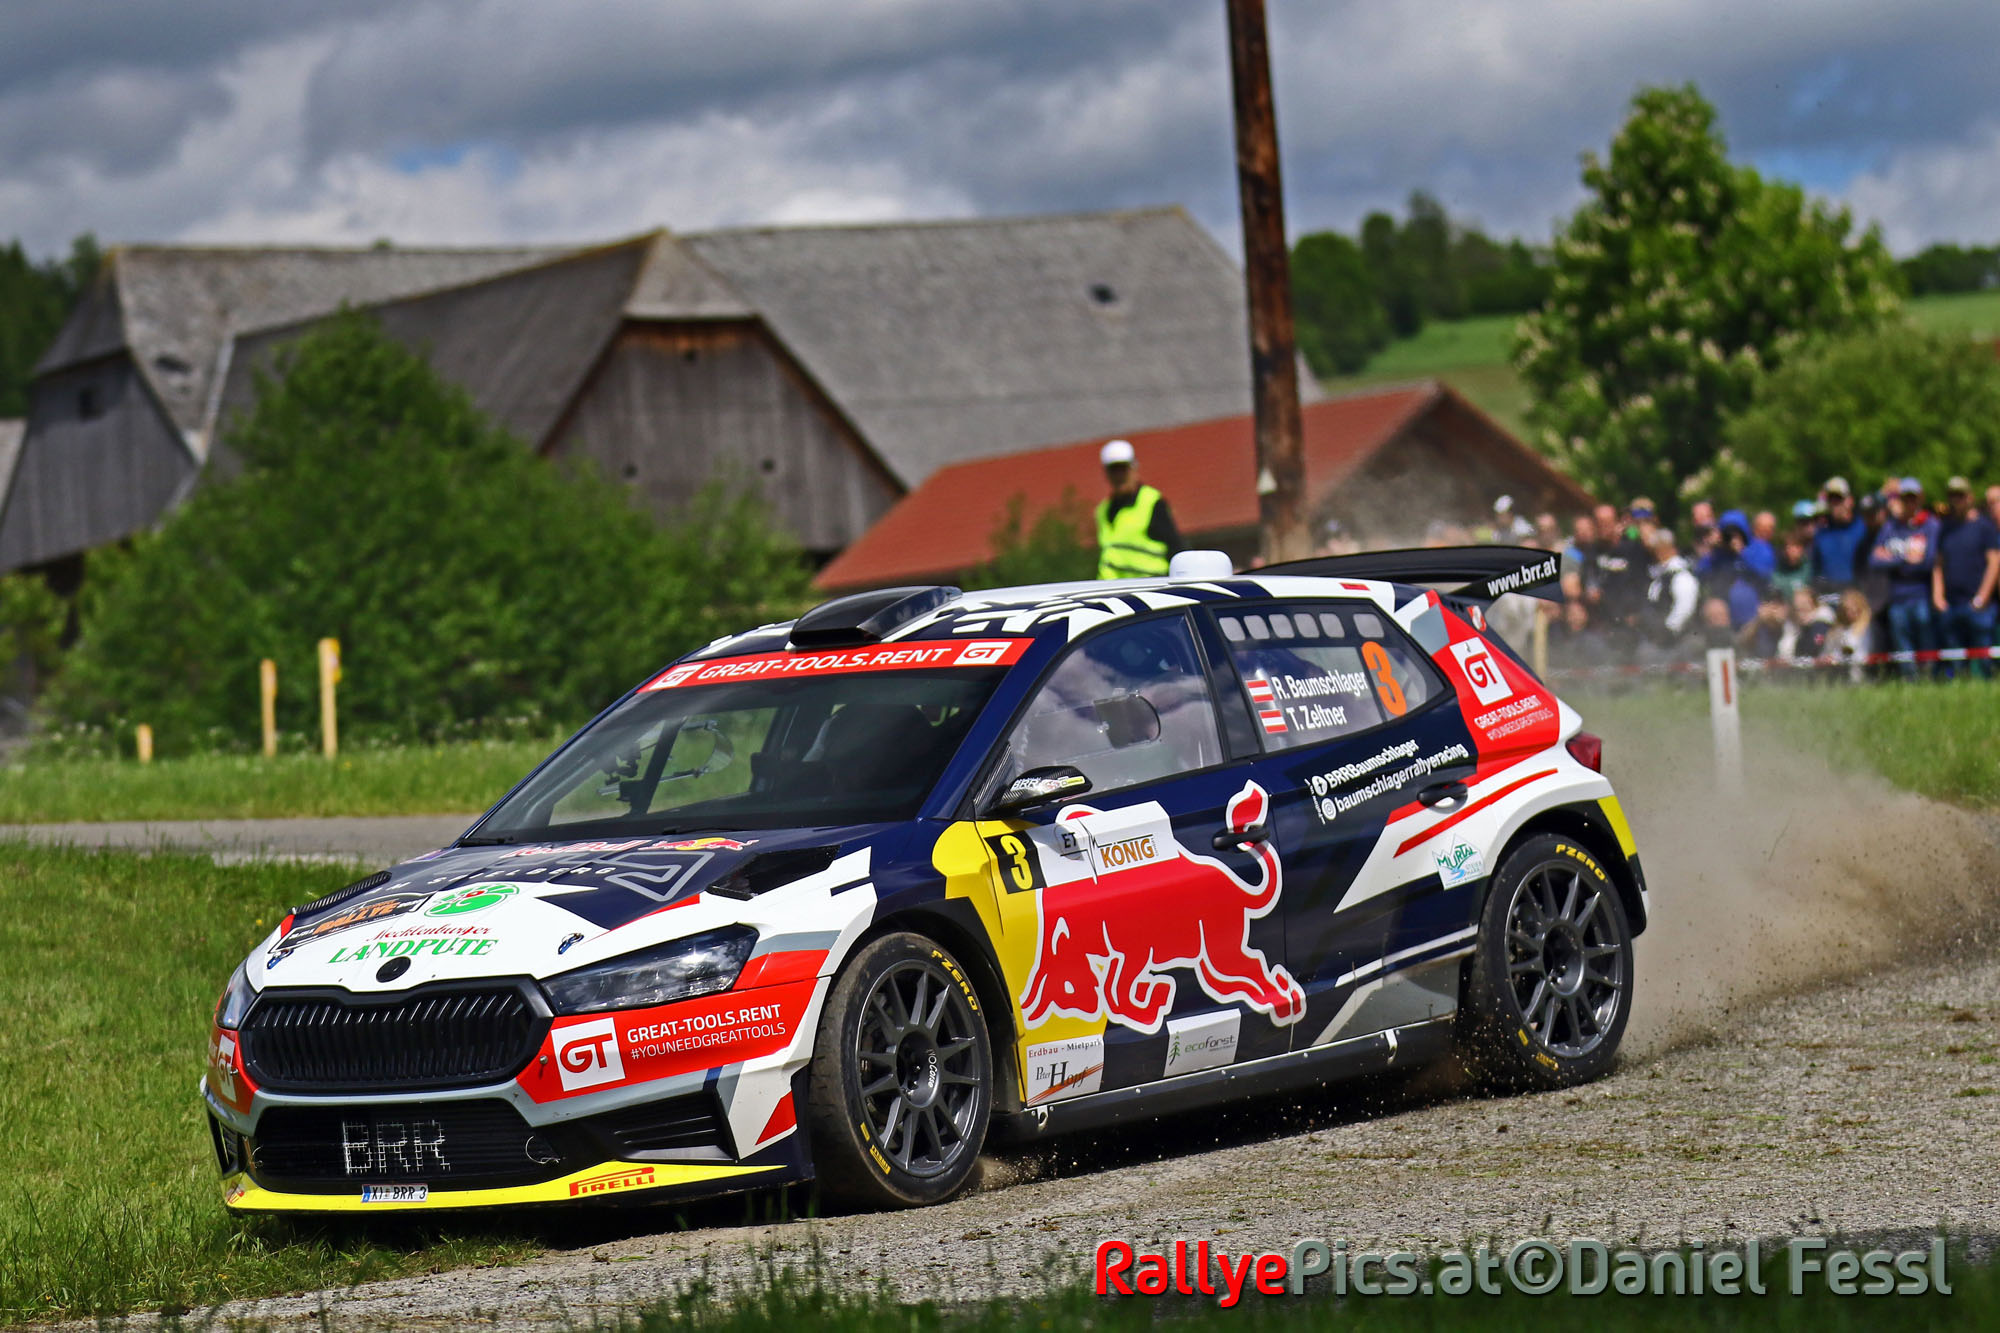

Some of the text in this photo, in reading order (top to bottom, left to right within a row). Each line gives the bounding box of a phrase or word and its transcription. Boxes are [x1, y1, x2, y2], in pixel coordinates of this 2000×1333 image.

[1487, 556, 1557, 597] www.brr.at
[697, 648, 952, 680] GREAT-TOOLS.RENT
[965, 646, 1006, 660] GT
[1362, 641, 1407, 716] 3
[1465, 652, 1498, 688] GT
[1271, 669, 1369, 700] R. Baumschlager
[1286, 704, 1348, 731] T. Zeltner
[1324, 739, 1420, 789] BRRBaumschlager
[1334, 743, 1469, 813] baumschlagerrallyeracing
[1061, 832, 1077, 849] ET
[1100, 837, 1154, 868] KÖNIG
[1000, 835, 1032, 890] 3
[328, 937, 499, 963] LANDPUTE
[627, 1004, 781, 1044] GREAT-TOOLS.RENT
[630, 1022, 786, 1060] #YOUNEEDGREATTOOLS
[559, 1033, 613, 1074] GT
[1028, 1045, 1059, 1058] Erdbau
[1184, 1035, 1236, 1053] ecoforst
[342, 1120, 451, 1175] BRR
[393, 1186, 416, 1200] BRR
[419, 1186, 427, 1200] 3
[569, 1166, 655, 1197] PIRELLI
